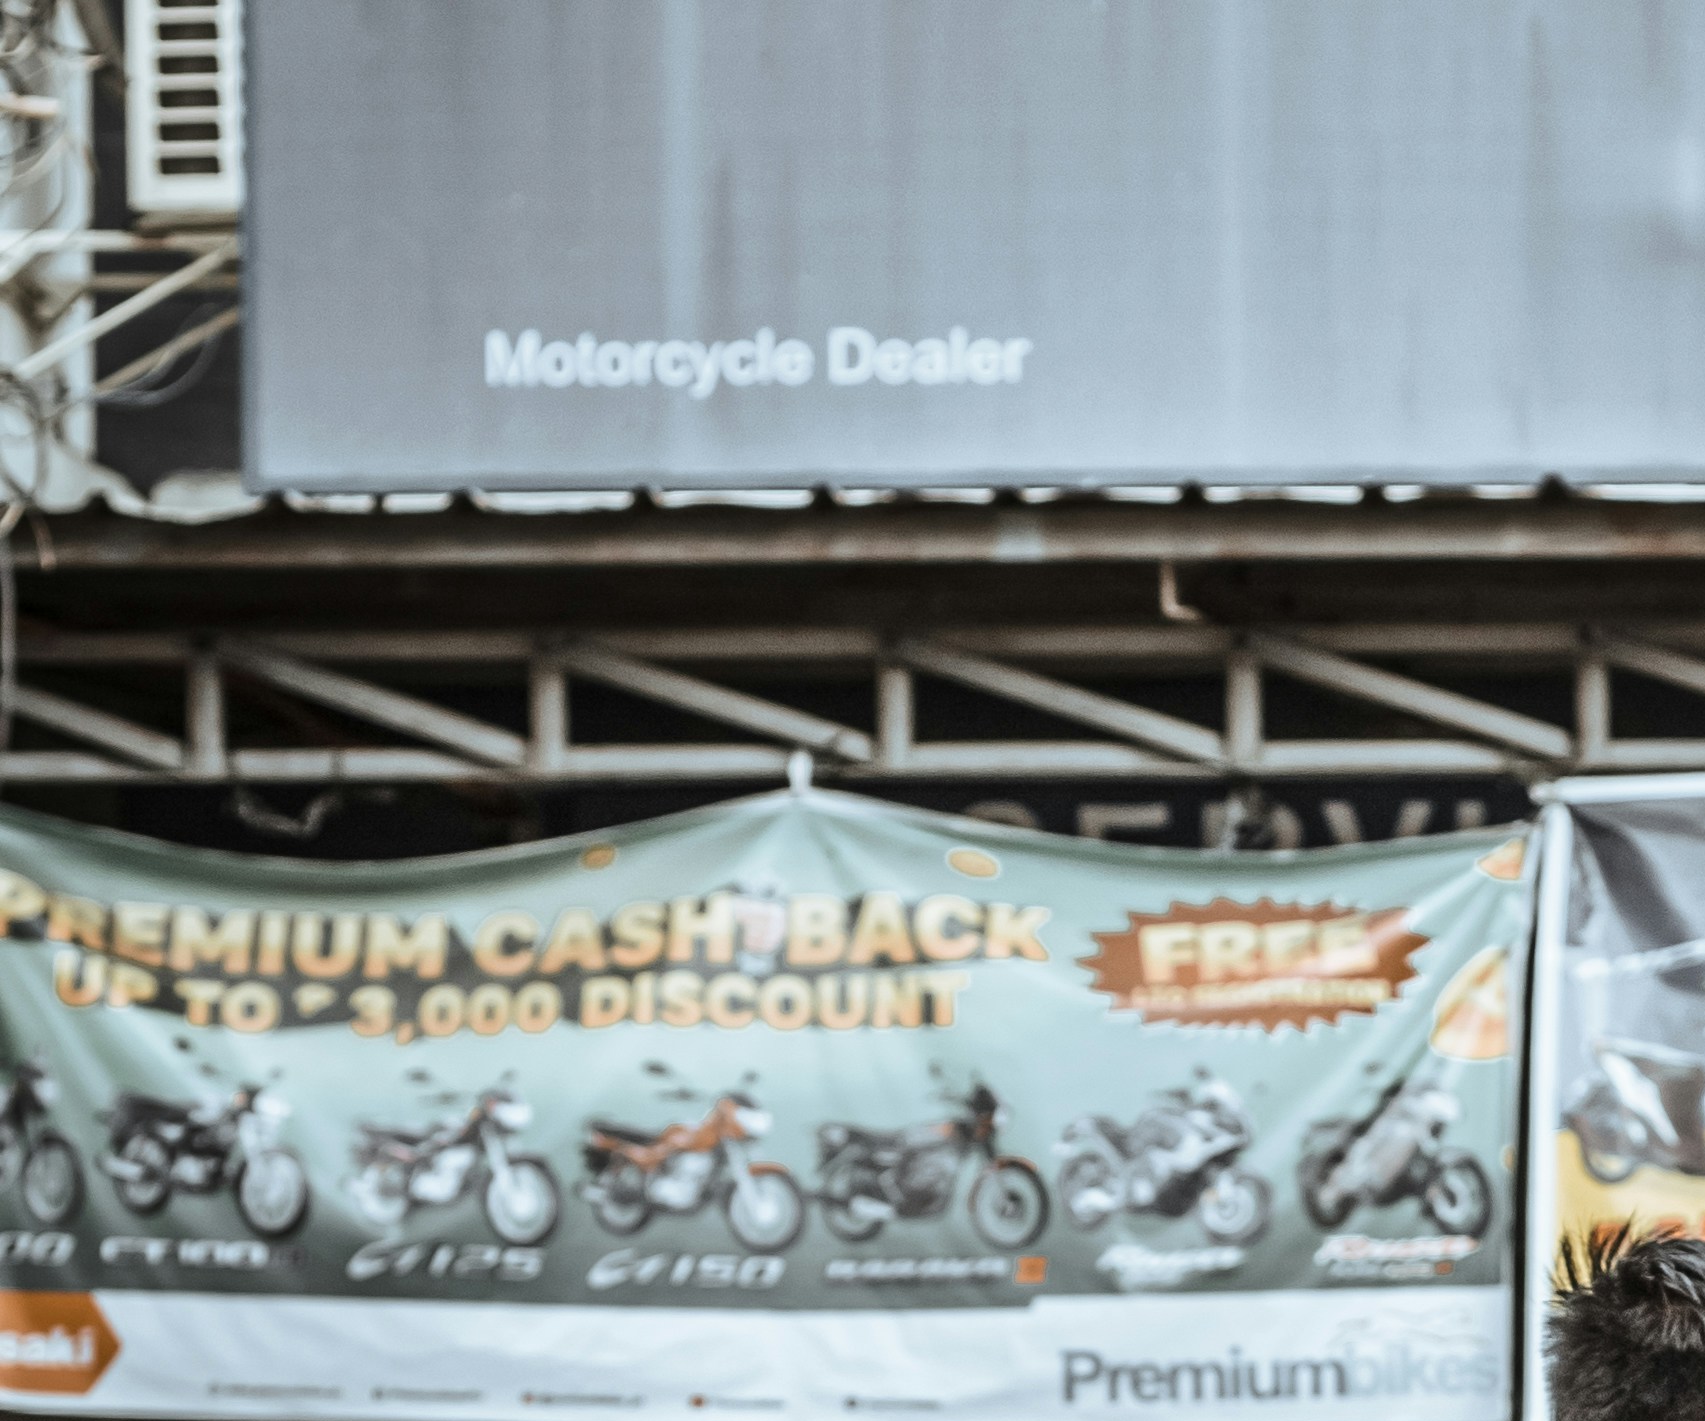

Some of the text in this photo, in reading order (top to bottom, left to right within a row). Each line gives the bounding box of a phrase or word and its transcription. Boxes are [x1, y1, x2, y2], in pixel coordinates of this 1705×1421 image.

[484, 326, 1033, 399] Motorcycle Dealer
[0, 868, 1050, 979] PREMIUM CASH BACK
[1138, 913, 1379, 984] FREE
[54, 950, 158, 1008] UP
[174, 976, 282, 1035] TO
[579, 969, 969, 1031] DISCOUNT
